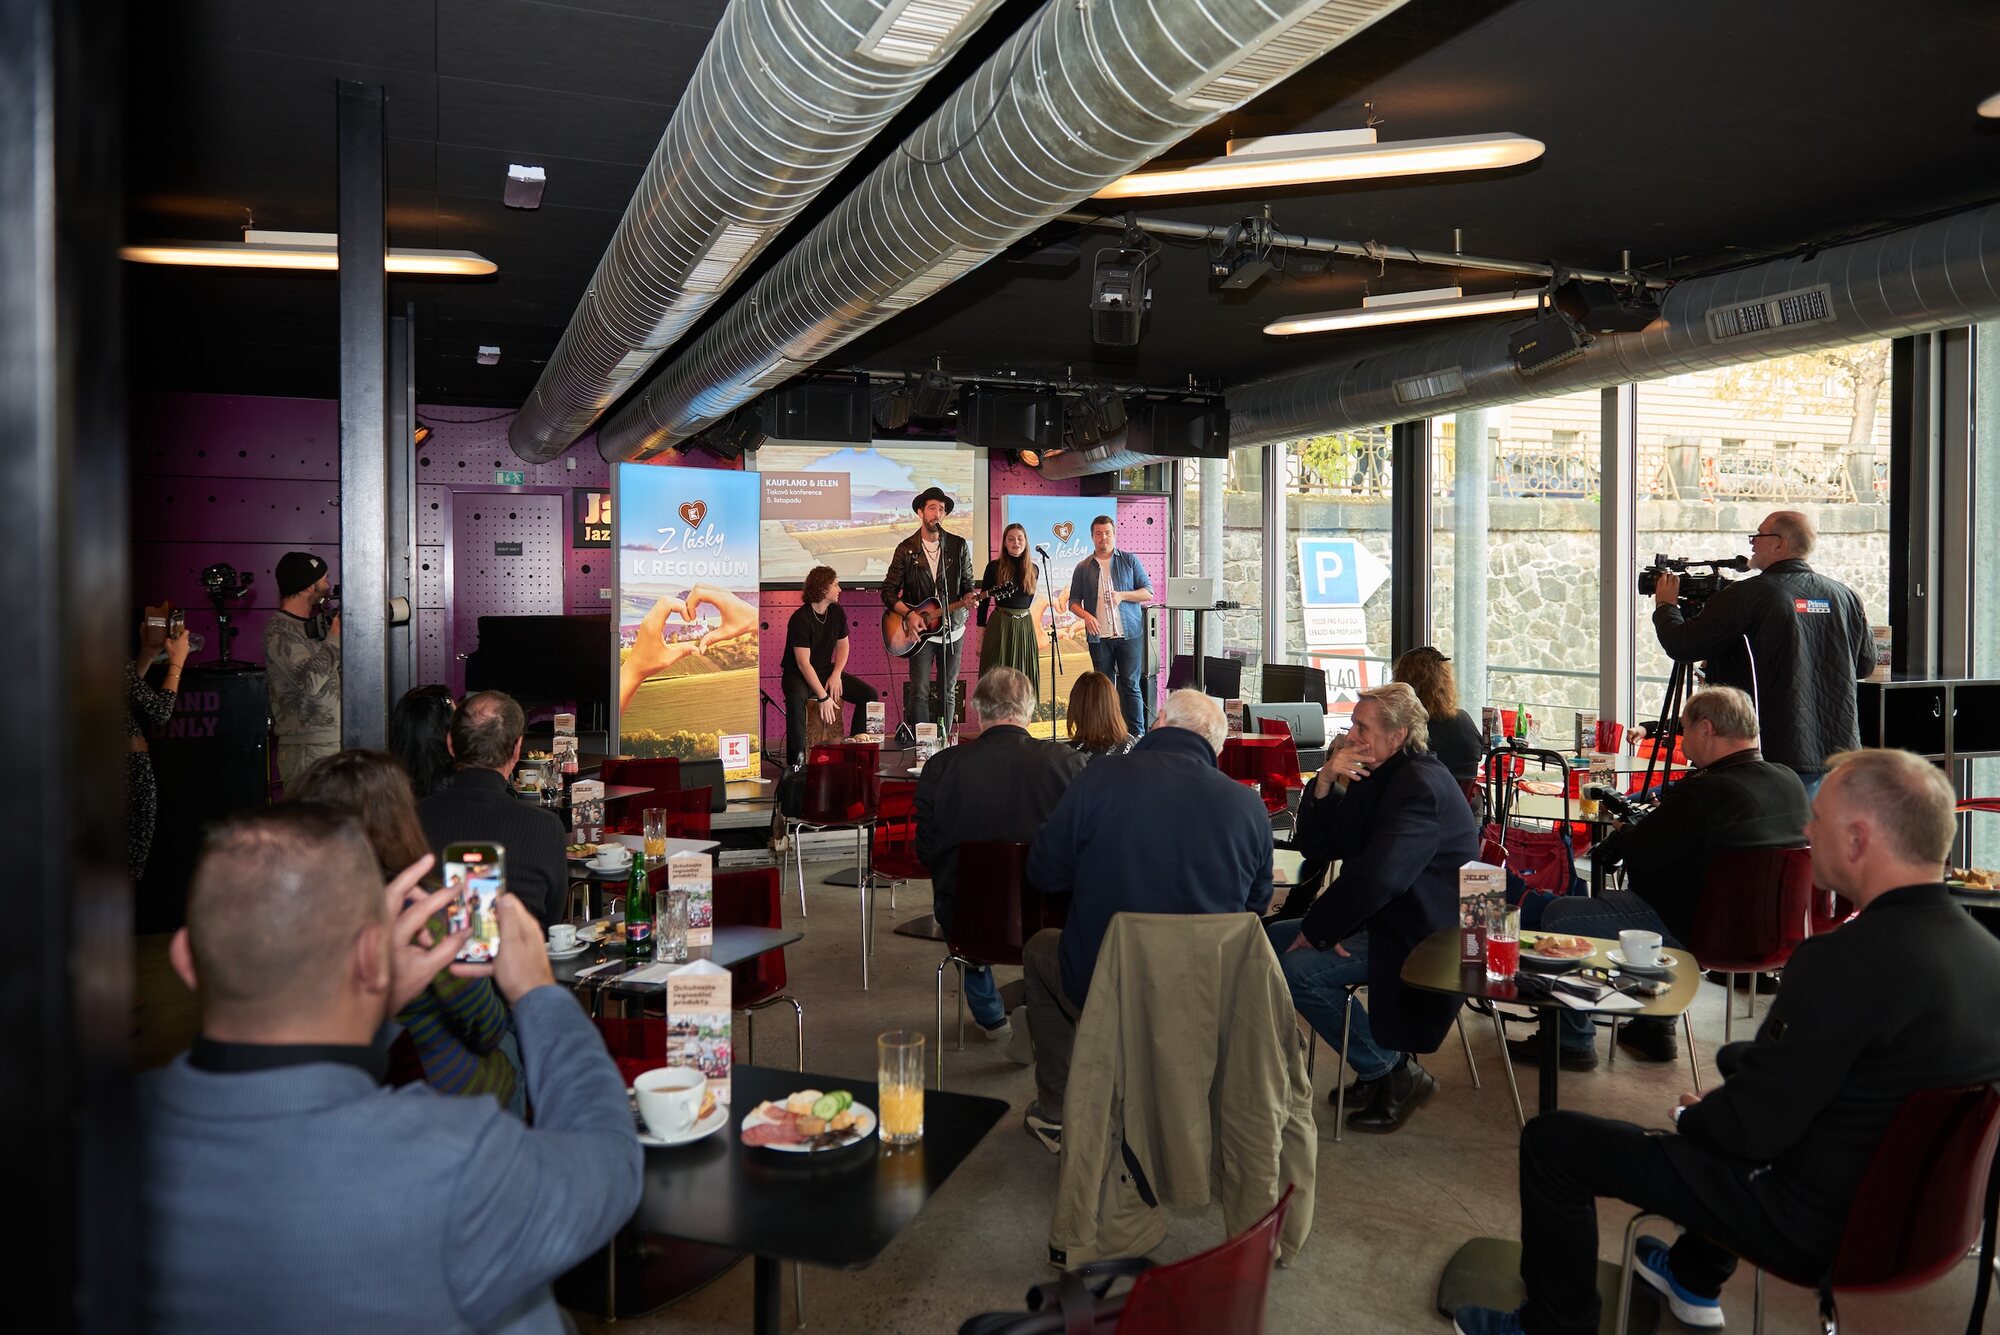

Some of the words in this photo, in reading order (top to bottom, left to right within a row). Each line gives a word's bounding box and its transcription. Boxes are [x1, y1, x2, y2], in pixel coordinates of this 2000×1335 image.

[765, 479, 808, 487] KAUFLAND
[809, 479, 816, 487] &
[816, 479, 839, 487] JELEN
[789, 488, 823, 496] konference
[657, 527, 678, 554] Z
[682, 523, 725, 557] lásky
[1055, 538, 1089, 560] lásky
[633, 559, 647, 576] K
[652, 556, 749, 577] REGIONŮM
[1314, 551, 1344, 595] P
[1807, 600, 1829, 608] Prima
